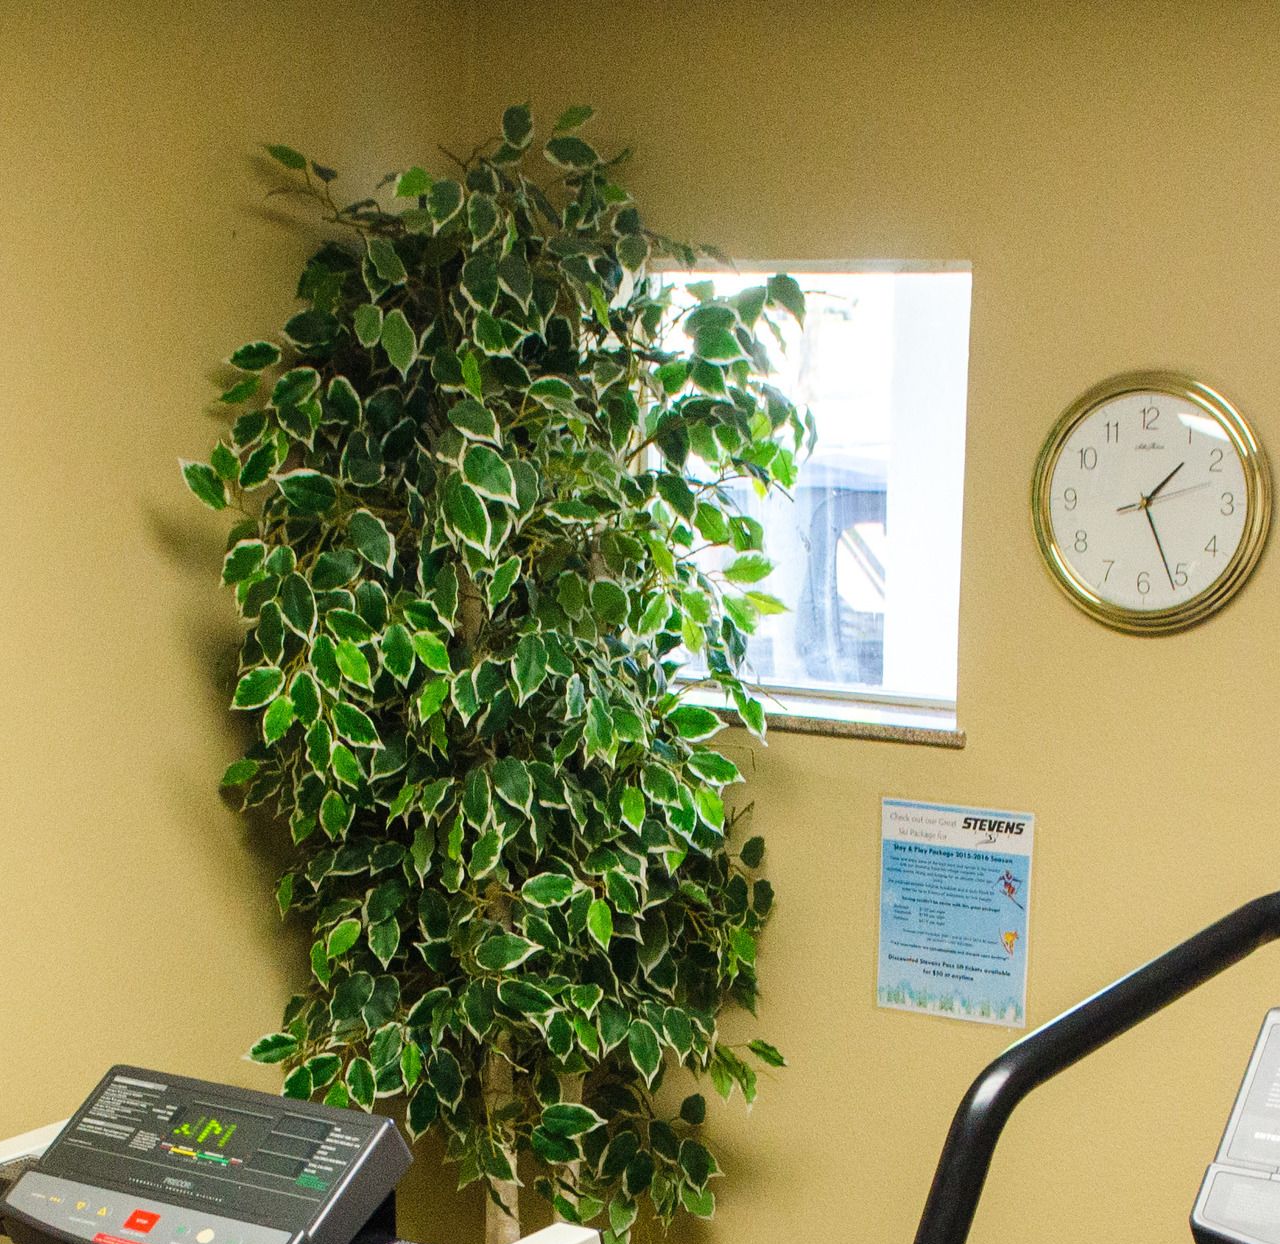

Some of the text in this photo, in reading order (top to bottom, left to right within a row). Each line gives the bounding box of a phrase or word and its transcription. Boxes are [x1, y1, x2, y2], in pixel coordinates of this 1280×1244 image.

[1140, 406, 1160, 431] 12
[1103, 421, 1120, 444] 11
[1079, 447, 1098, 471] 10
[1208, 448, 1224, 473] 2
[1063, 487, 1078, 511] 9
[1220, 492, 1235, 517] 3
[1074, 530, 1088, 553] 8
[1204, 535, 1219, 558] 4
[1102, 559, 1115, 583] 7
[1137, 571, 1151, 595] 6
[1174, 562, 1190, 586] 5
[910, 828, 936, 841] Package
[962, 817, 1026, 835] STEVENS
[913, 846, 927, 855] Play
[929, 847, 954, 858] Package
[920, 958, 941, 967] Stevens
[942, 961, 955, 969] Pass
[984, 967, 1011, 977] available
